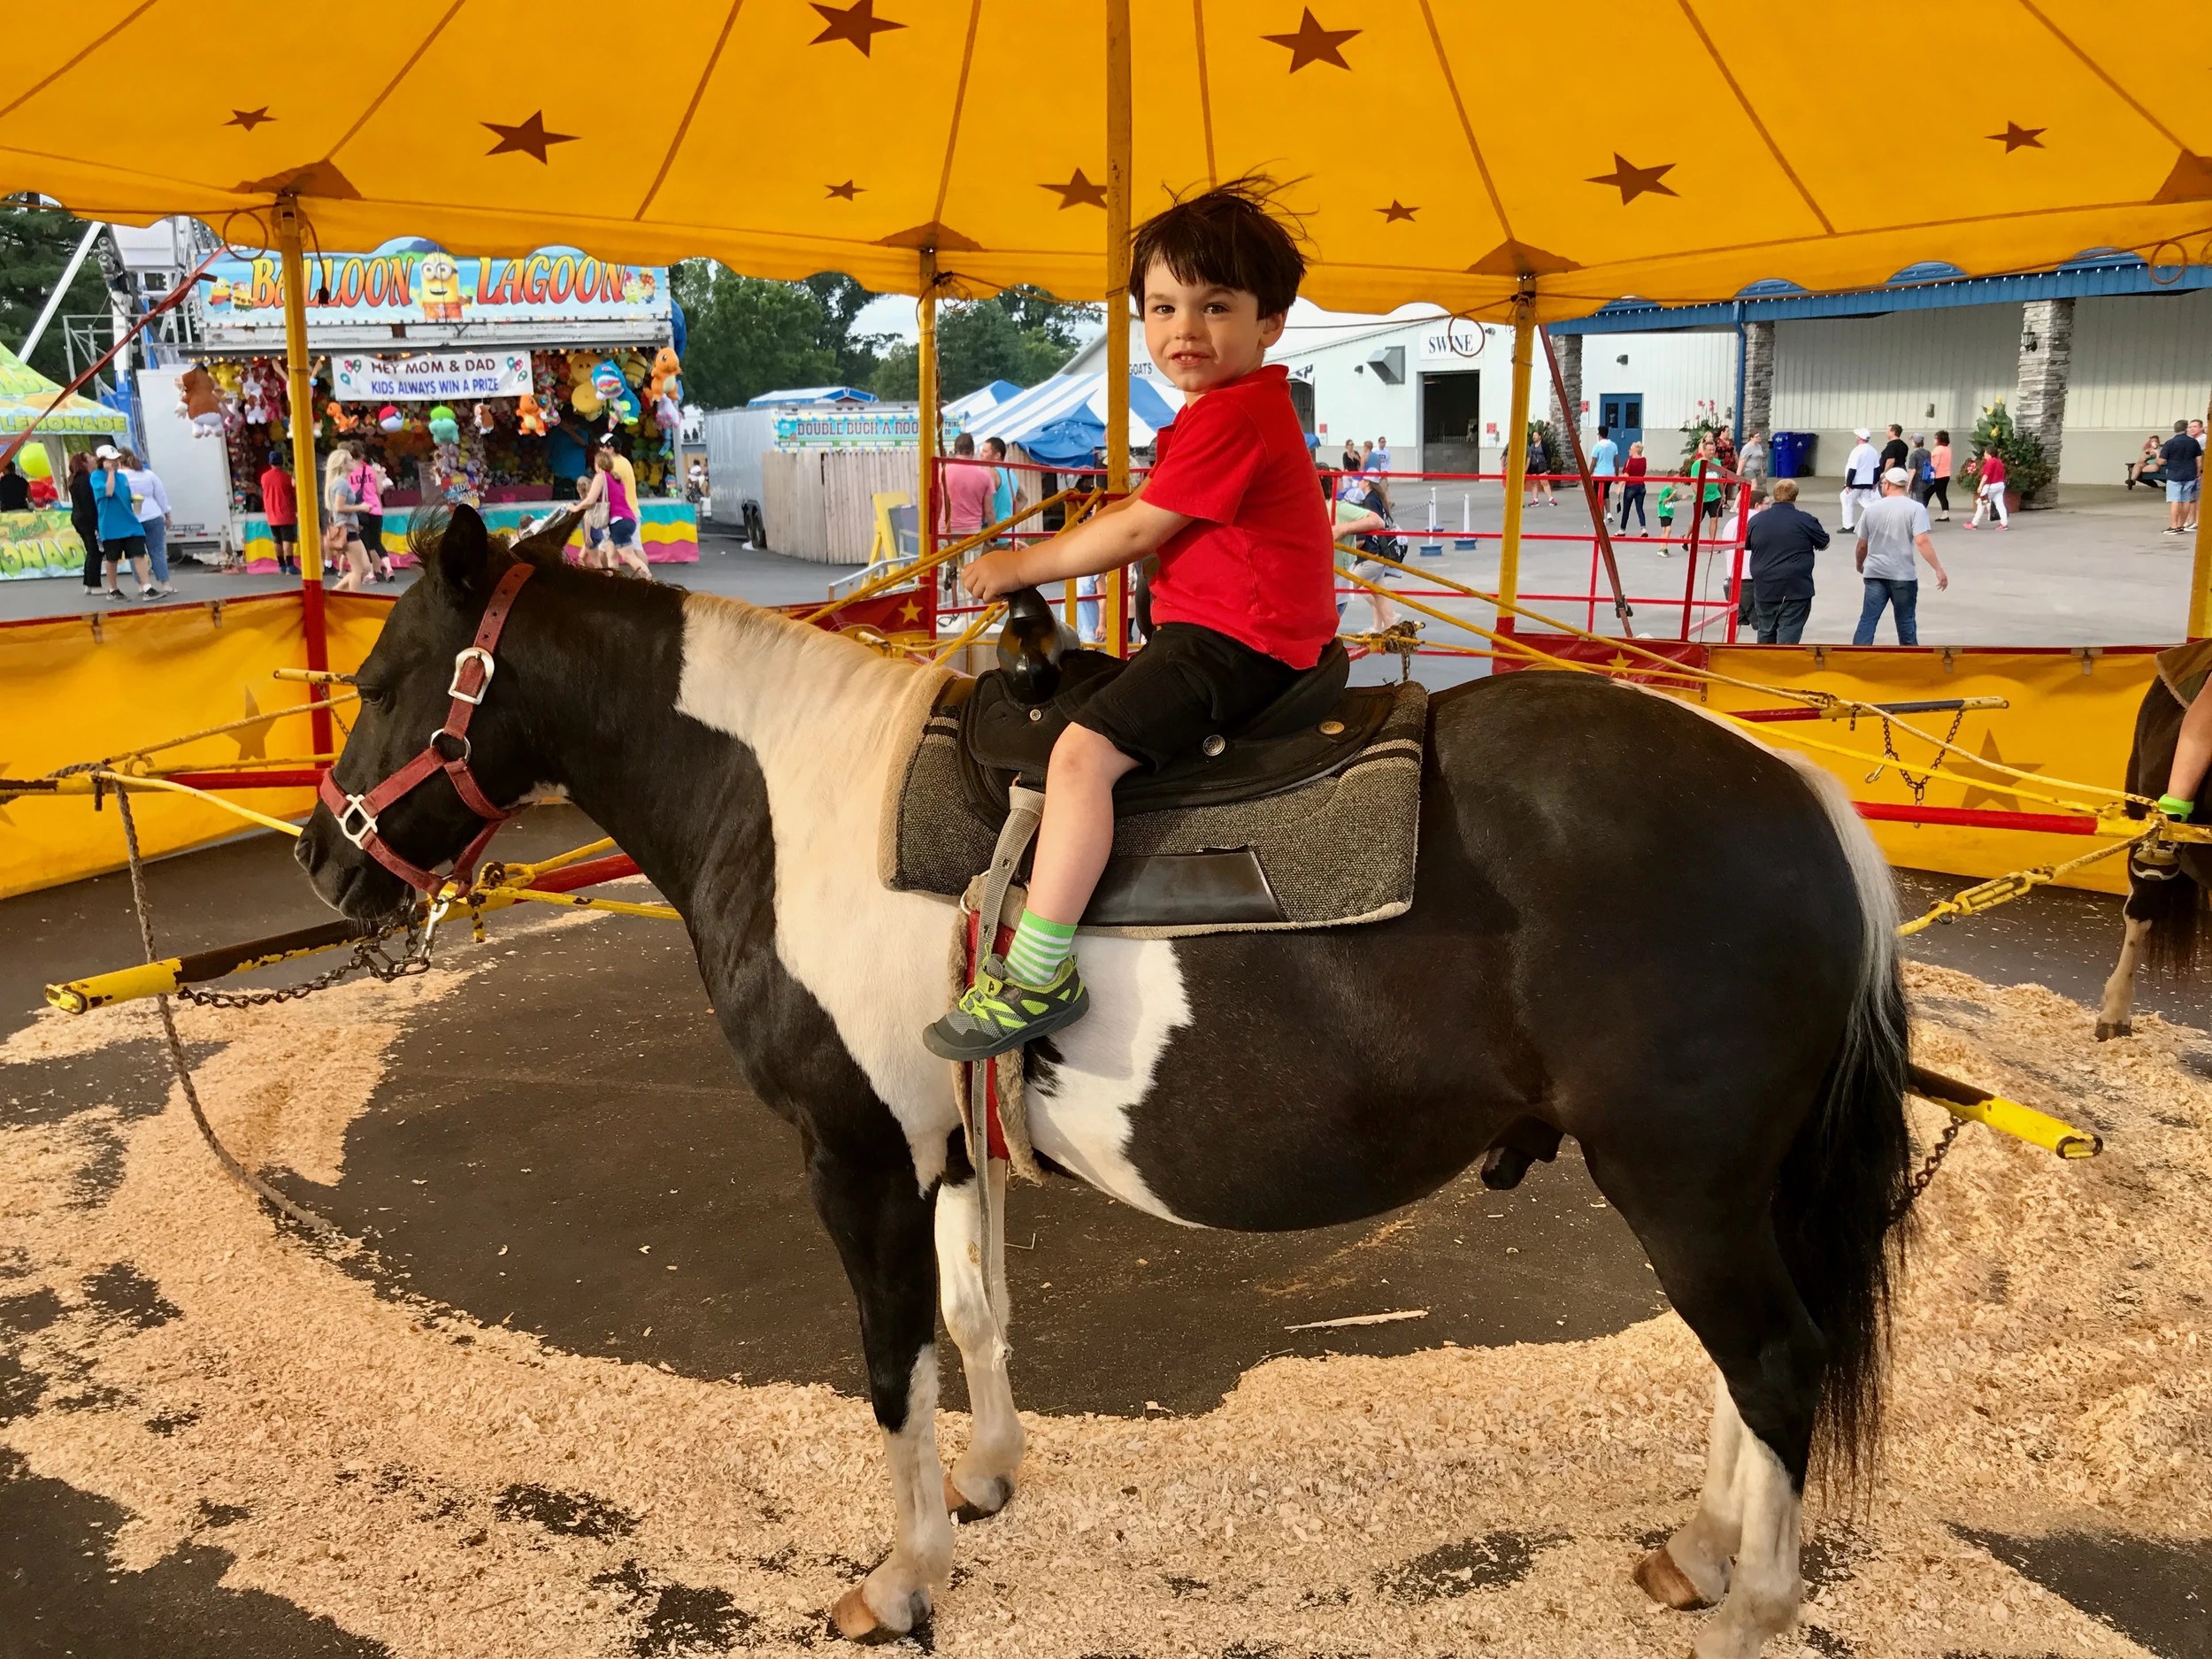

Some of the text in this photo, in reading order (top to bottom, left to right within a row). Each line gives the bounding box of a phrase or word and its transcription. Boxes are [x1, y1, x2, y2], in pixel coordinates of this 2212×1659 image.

[476, 254, 626, 305] LAGOON
[1428, 334, 1474, 354] SWINE
[371, 358, 495, 374] HEY MOM & DAD
[371, 377, 499, 395] KIDS ALWAYS WIN A PRIZE
[1, 415, 127, 434] LEMONADE
[797, 422, 843, 435] DOUBLE
